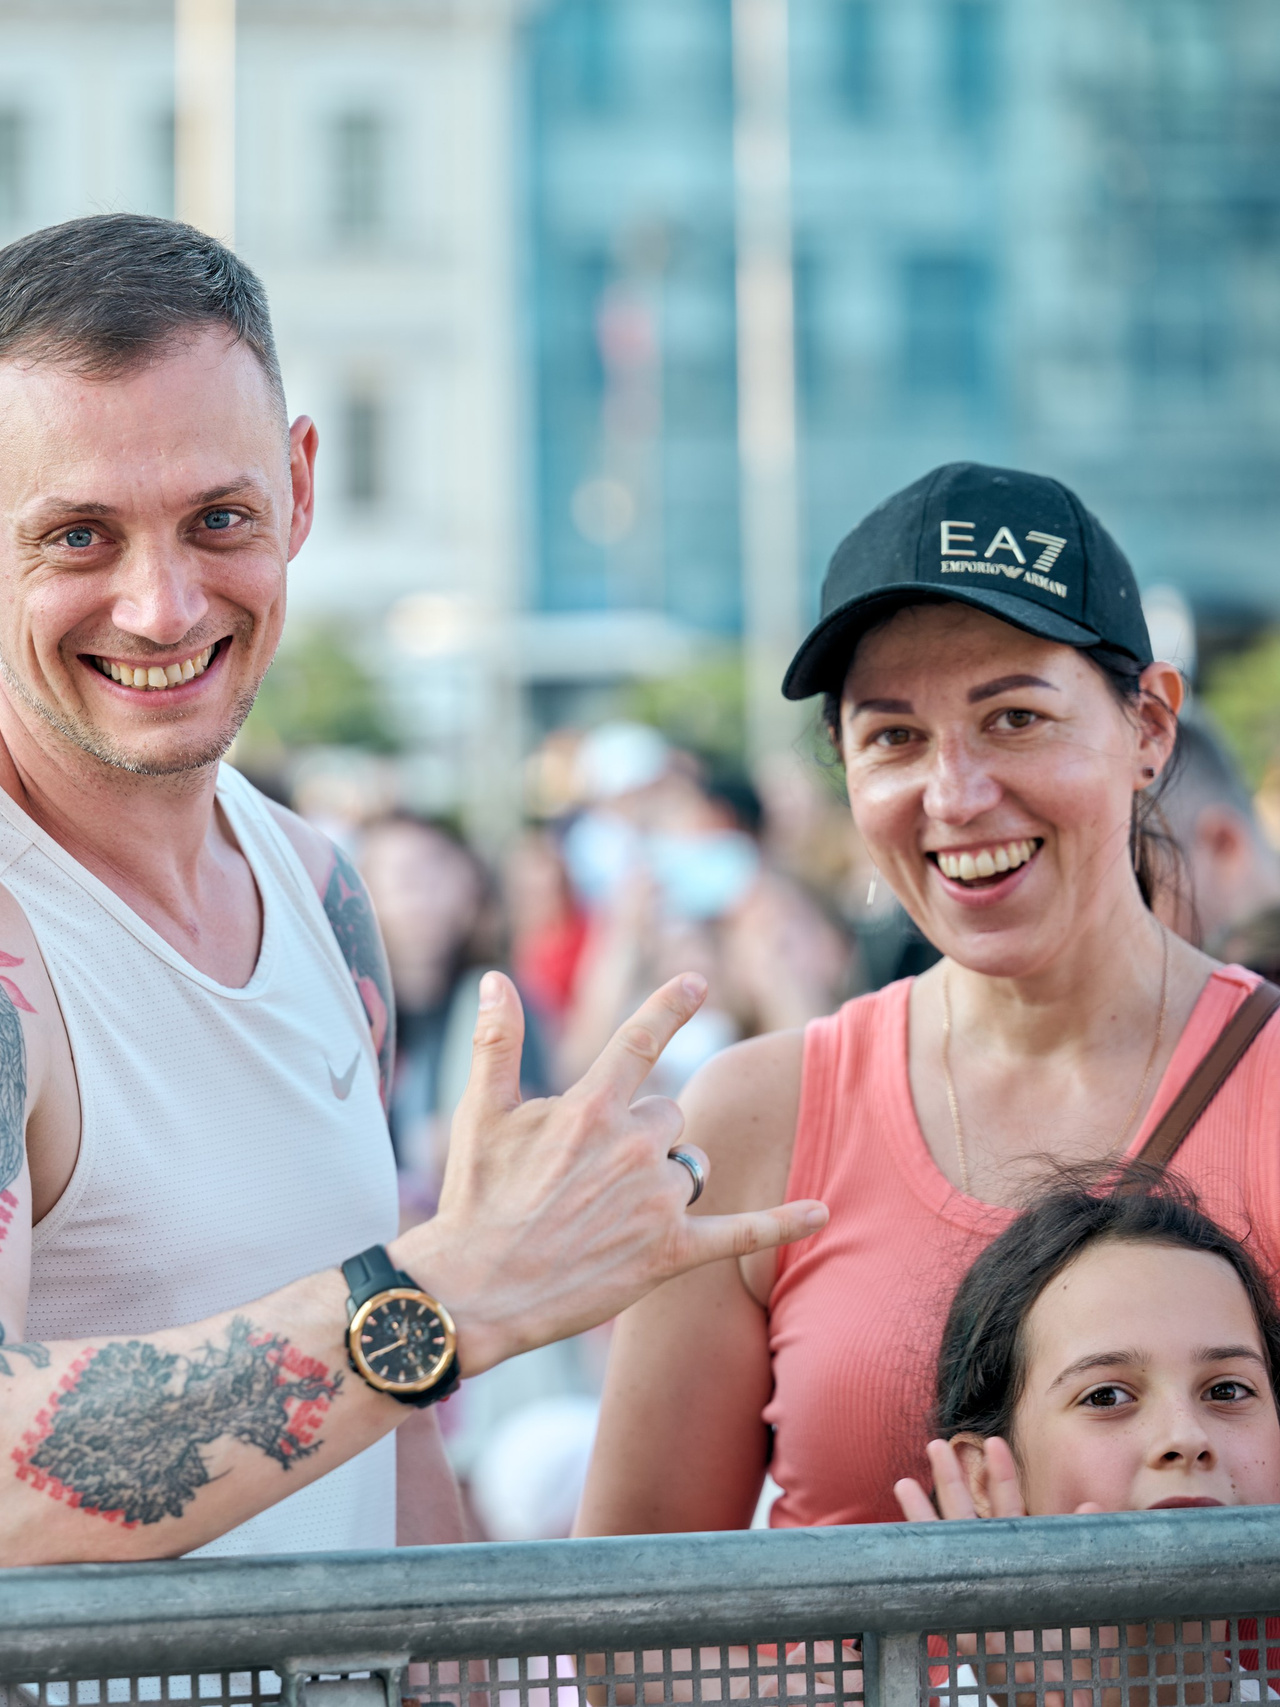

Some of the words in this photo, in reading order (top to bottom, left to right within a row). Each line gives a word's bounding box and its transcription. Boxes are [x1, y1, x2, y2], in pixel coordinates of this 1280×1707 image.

[940, 520, 1068, 573] EA7
[940, 560, 1001, 576] EMPORIO
[1023, 571, 1068, 598] ARMANI
